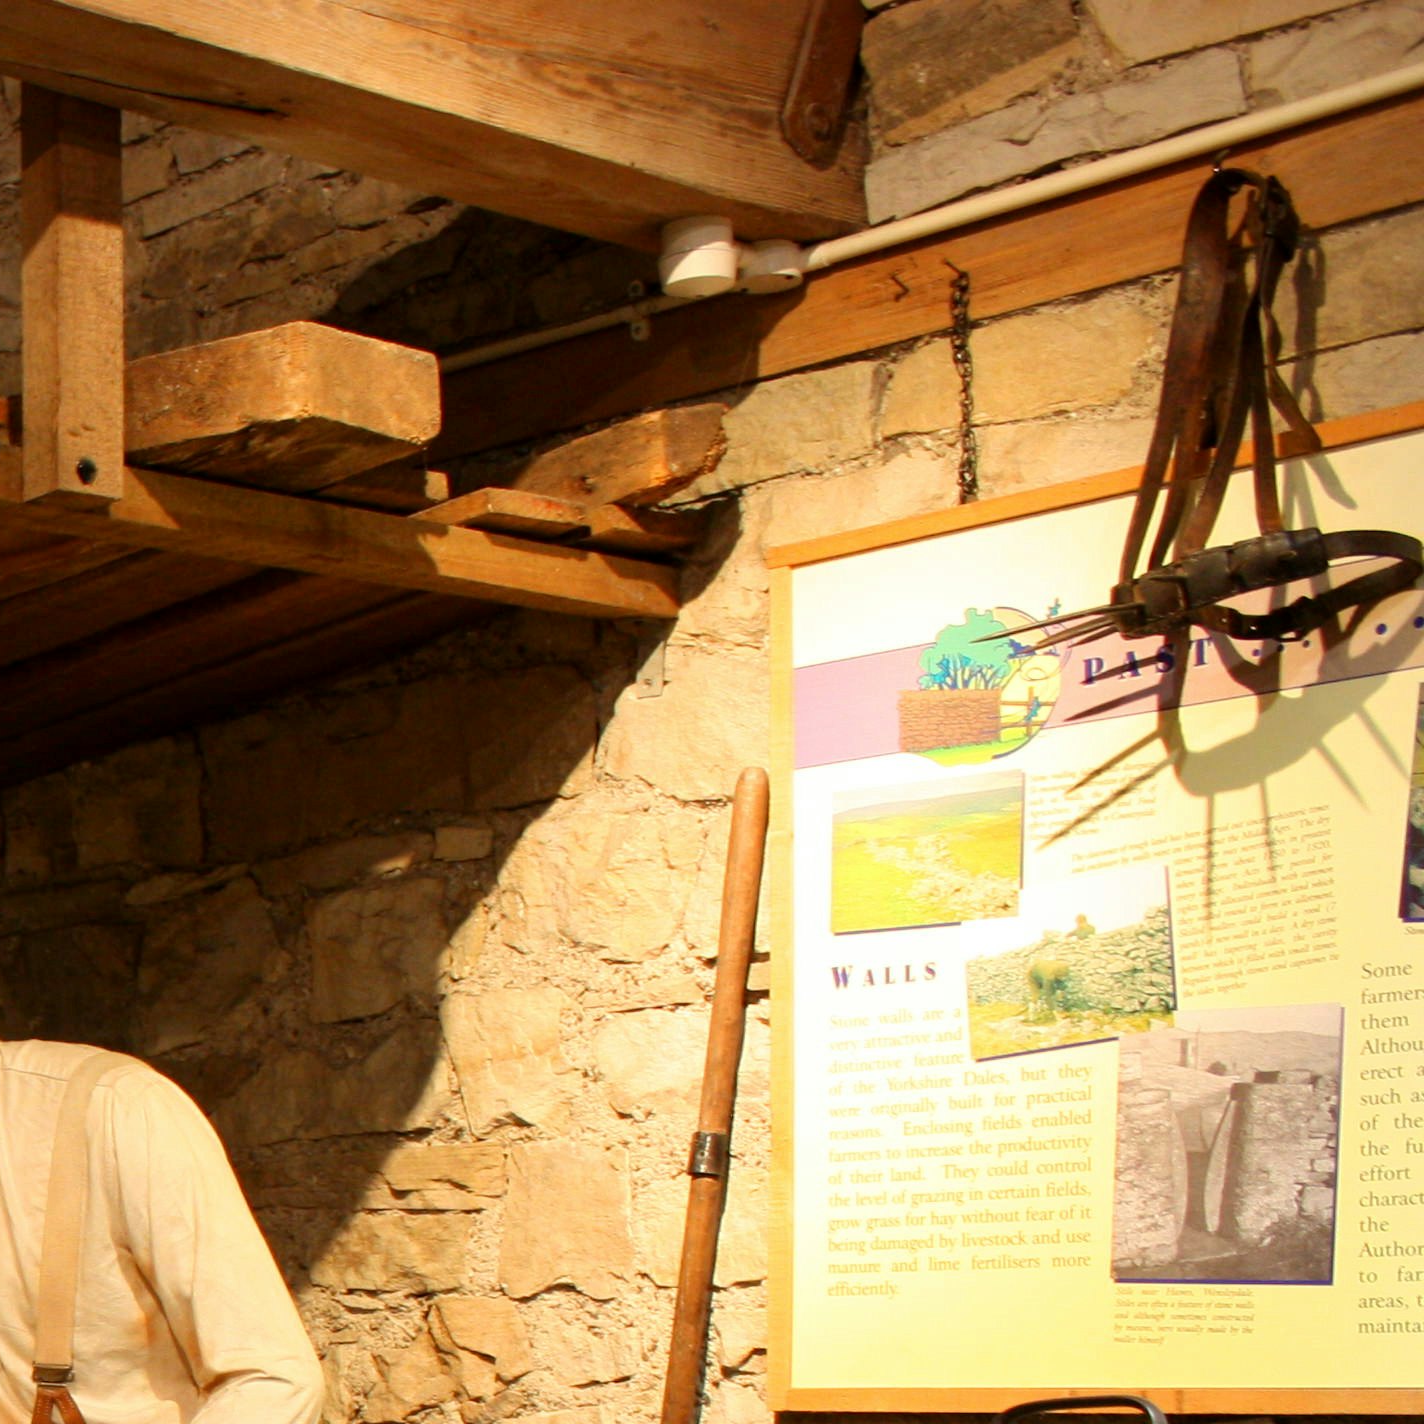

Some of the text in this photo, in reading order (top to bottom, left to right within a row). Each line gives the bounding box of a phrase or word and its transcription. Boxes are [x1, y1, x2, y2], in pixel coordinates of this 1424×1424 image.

[1083, 637, 1213, 685] PAST
[832, 961, 938, 989] WALLS
[1360, 962, 1413, 980] Some
[1360, 1014, 1410, 1030] them
[853, 1080, 875, 1094] the
[887, 1076, 952, 1091] Yorkshire
[963, 1071, 1010, 1086] Dales,
[1021, 1066, 1047, 1081] but
[1058, 1064, 1092, 1081] they
[1360, 1066, 1405, 1080] erect
[870, 1098, 937, 1116] originally
[948, 1094, 982, 1110] built
[994, 1092, 1016, 1106] for
[1026, 1086, 1092, 1109] practical
[1360, 1088, 1401, 1106] such
[902, 1120, 973, 1137] Enclosing
[982, 1115, 1022, 1130] fields
[1032, 1110, 1092, 1128] enabled
[1360, 1114, 1380, 1131] of
[828, 1135, 1092, 1162] farmers to increase the productivity
[1360, 1140, 1390, 1156] the
[828, 1157, 1092, 1185] of their land. They could control
[1359, 1164, 1412, 1182] effort
[828, 1181, 1092, 1208] the level of grazing in certain fields,
[828, 1204, 1091, 1233] grow grass for hay without fear of it
[1359, 1216, 1390, 1232] the
[828, 1229, 1091, 1255] being damaged by livestock and use
[828, 1254, 1092, 1274] manure and lime fertilisers more
[1358, 1270, 1378, 1283] to
[1358, 1296, 1408, 1310] areas,
